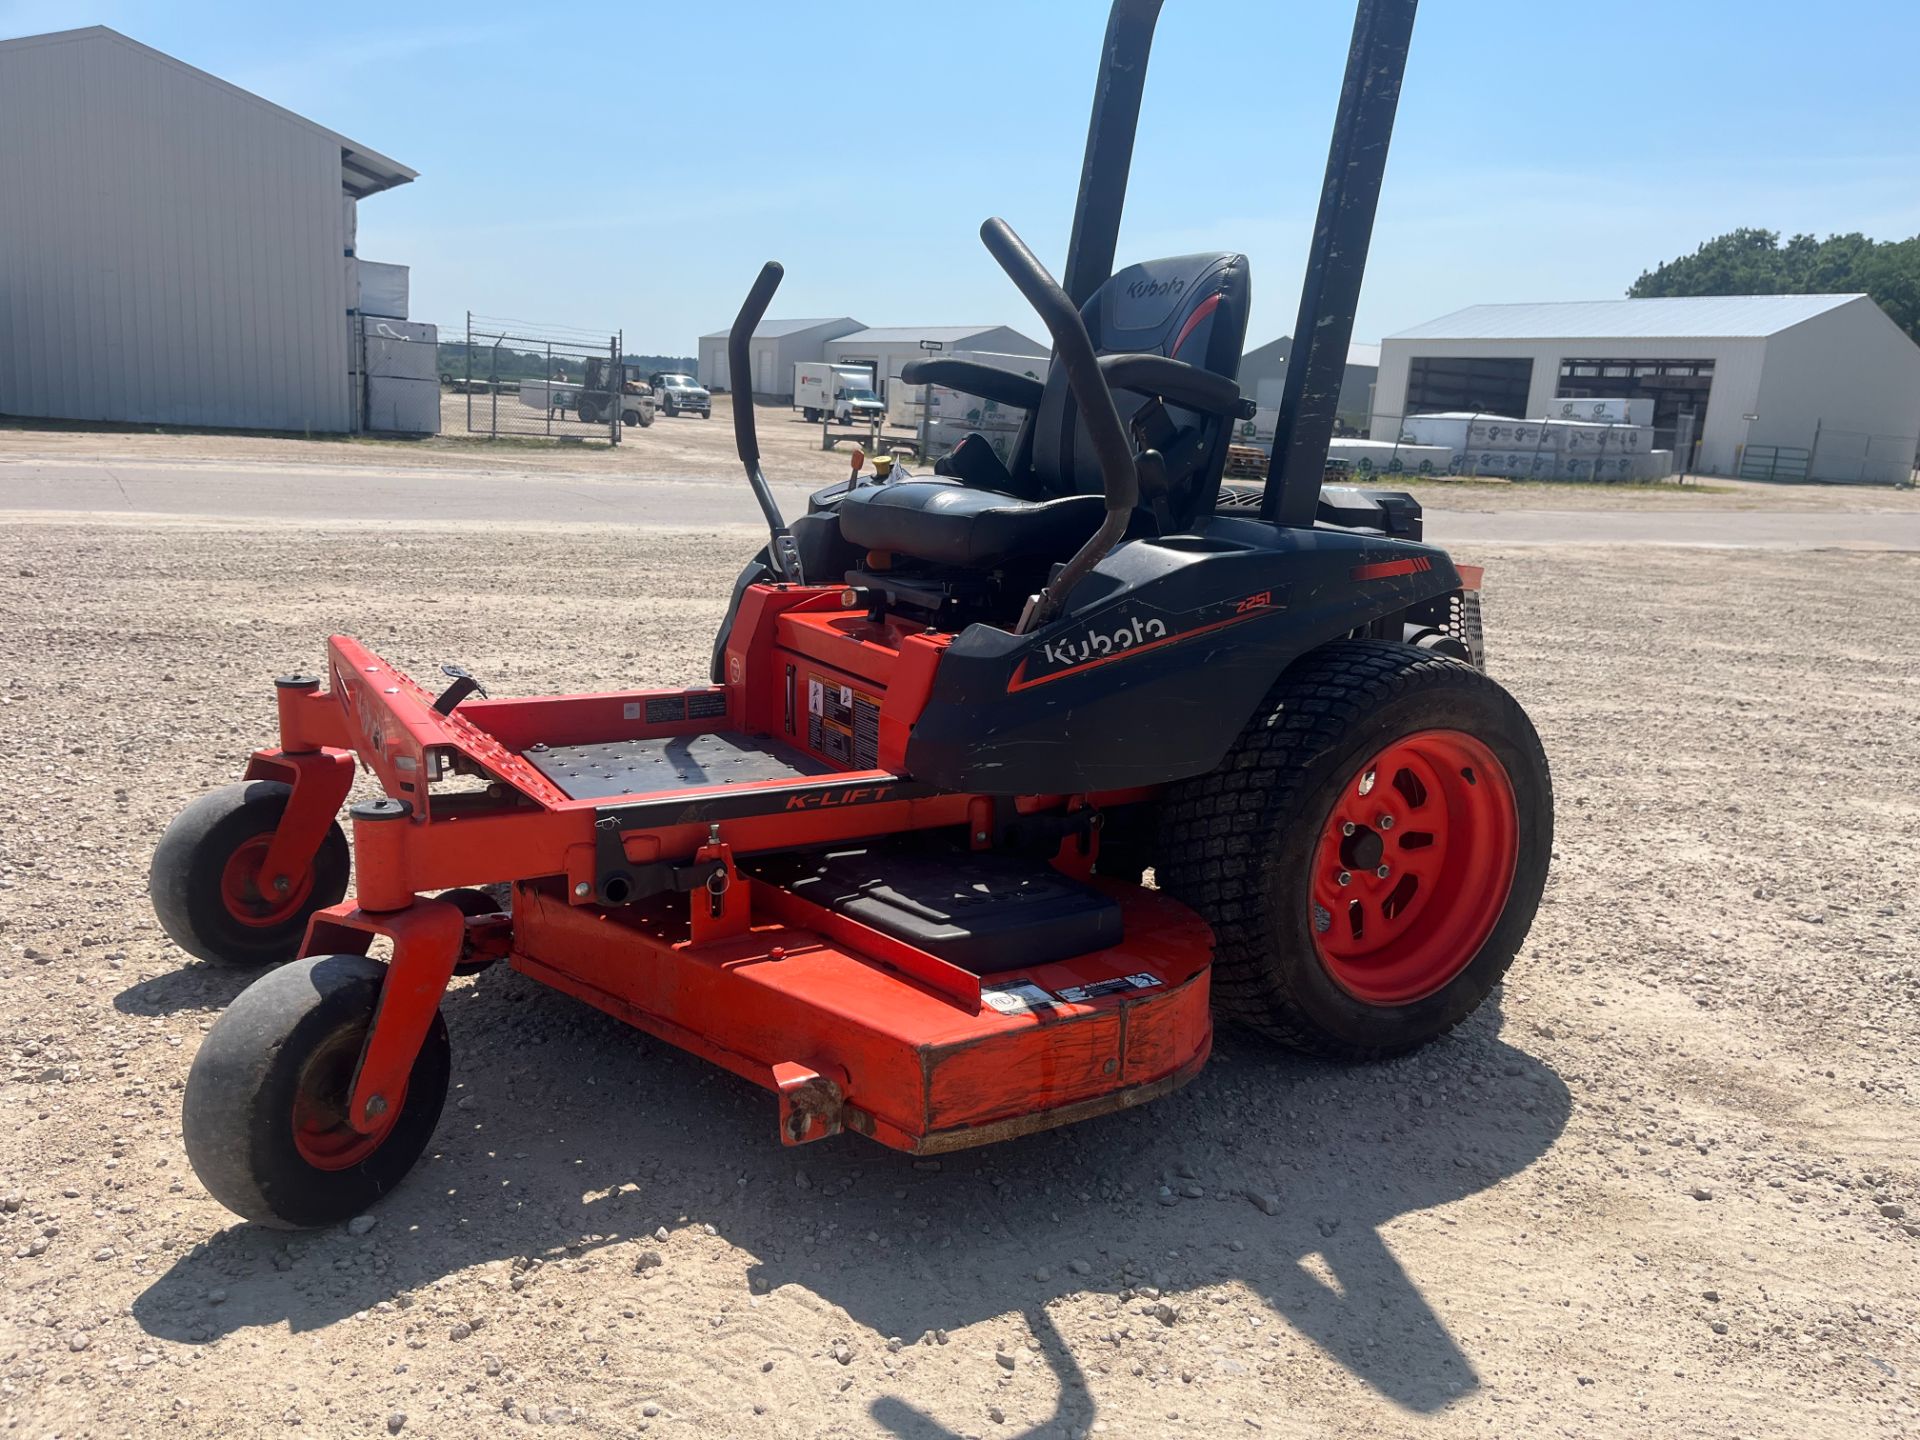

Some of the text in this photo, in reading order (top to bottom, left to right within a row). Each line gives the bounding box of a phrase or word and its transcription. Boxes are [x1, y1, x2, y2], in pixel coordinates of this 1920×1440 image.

[1126, 276, 1184, 298] Kubota
[1236, 591, 1271, 613] Z251
[1043, 616, 1167, 665] Kubota
[785, 786, 894, 809] K-LIFT
